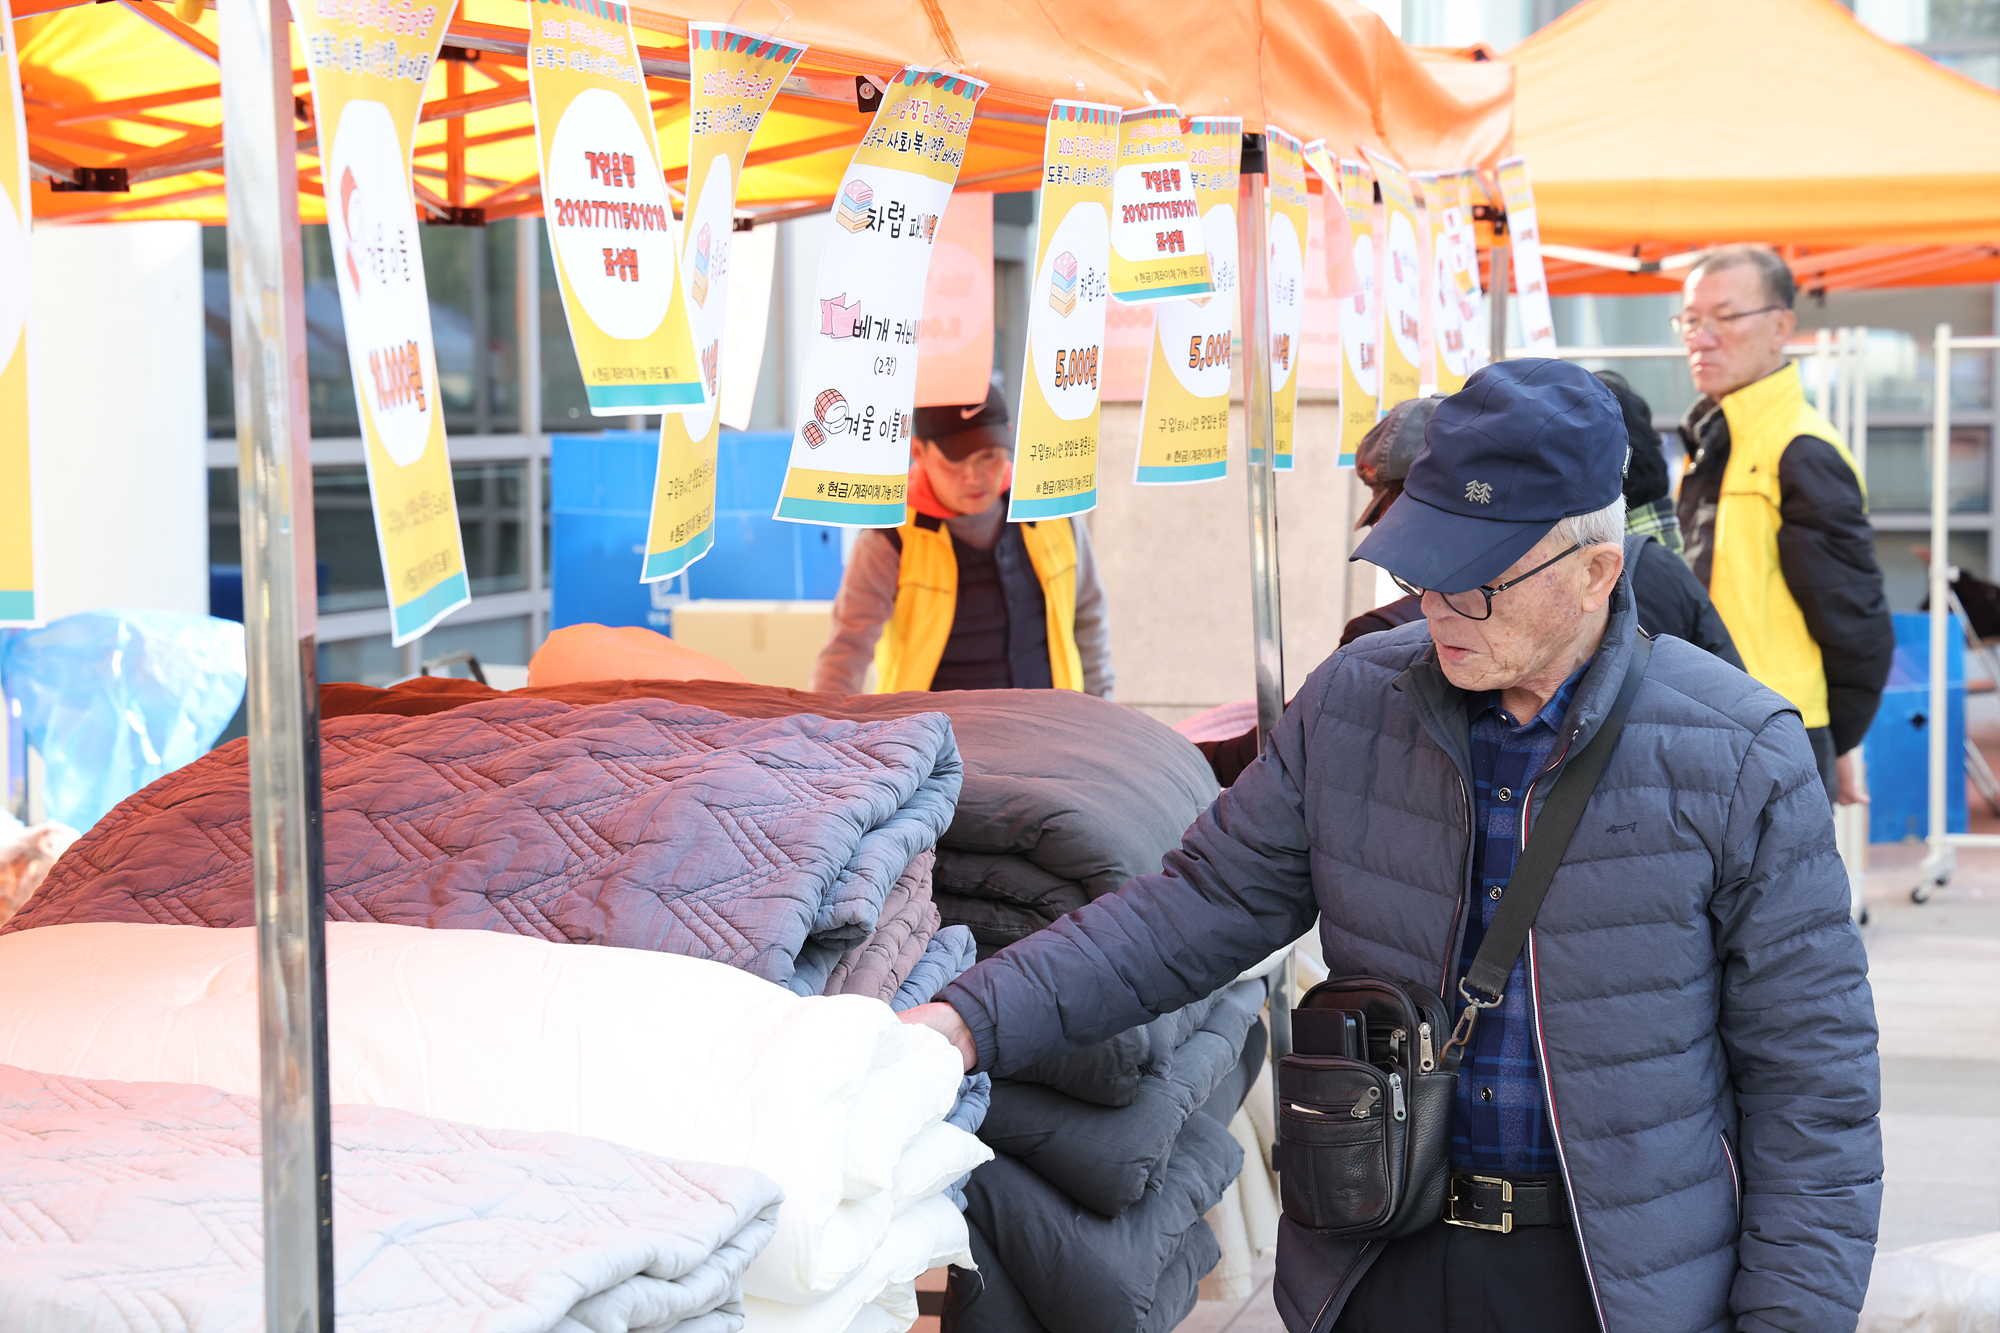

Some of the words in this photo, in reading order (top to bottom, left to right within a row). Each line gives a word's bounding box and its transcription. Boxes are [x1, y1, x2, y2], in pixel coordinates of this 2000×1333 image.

[535, 44, 566, 70] 도봉구
[1058, 136, 1075, 155] 2025
[585, 151, 635, 188] 기업은행
[1047, 161, 1070, 187] 도봉구
[1141, 168, 1181, 193] 기업은행
[1190, 171, 1208, 193] 봉구
[866, 200, 905, 238] 차렵
[1155, 229, 1185, 254] 조성철
[603, 247, 639, 282] 조성철
[852, 315, 890, 342] 베개
[874, 356, 897, 376] (2장)
[1055, 344, 1098, 391] 5,000원
[845, 405, 875, 441] 겨울
[879, 408, 901, 443] 이불
[1158, 416, 1199, 433] 구입하시면
[1030, 443, 1063, 461] 구입하시면
[1064, 439, 1079, 458] 맛있는
[1174, 447, 1212, 463] 현금/계좌이체
[828, 481, 880, 500] 현금/계좌이체
[881, 485, 891, 500] 가능
[1042, 478, 1074, 495] 현금/계좌이체
